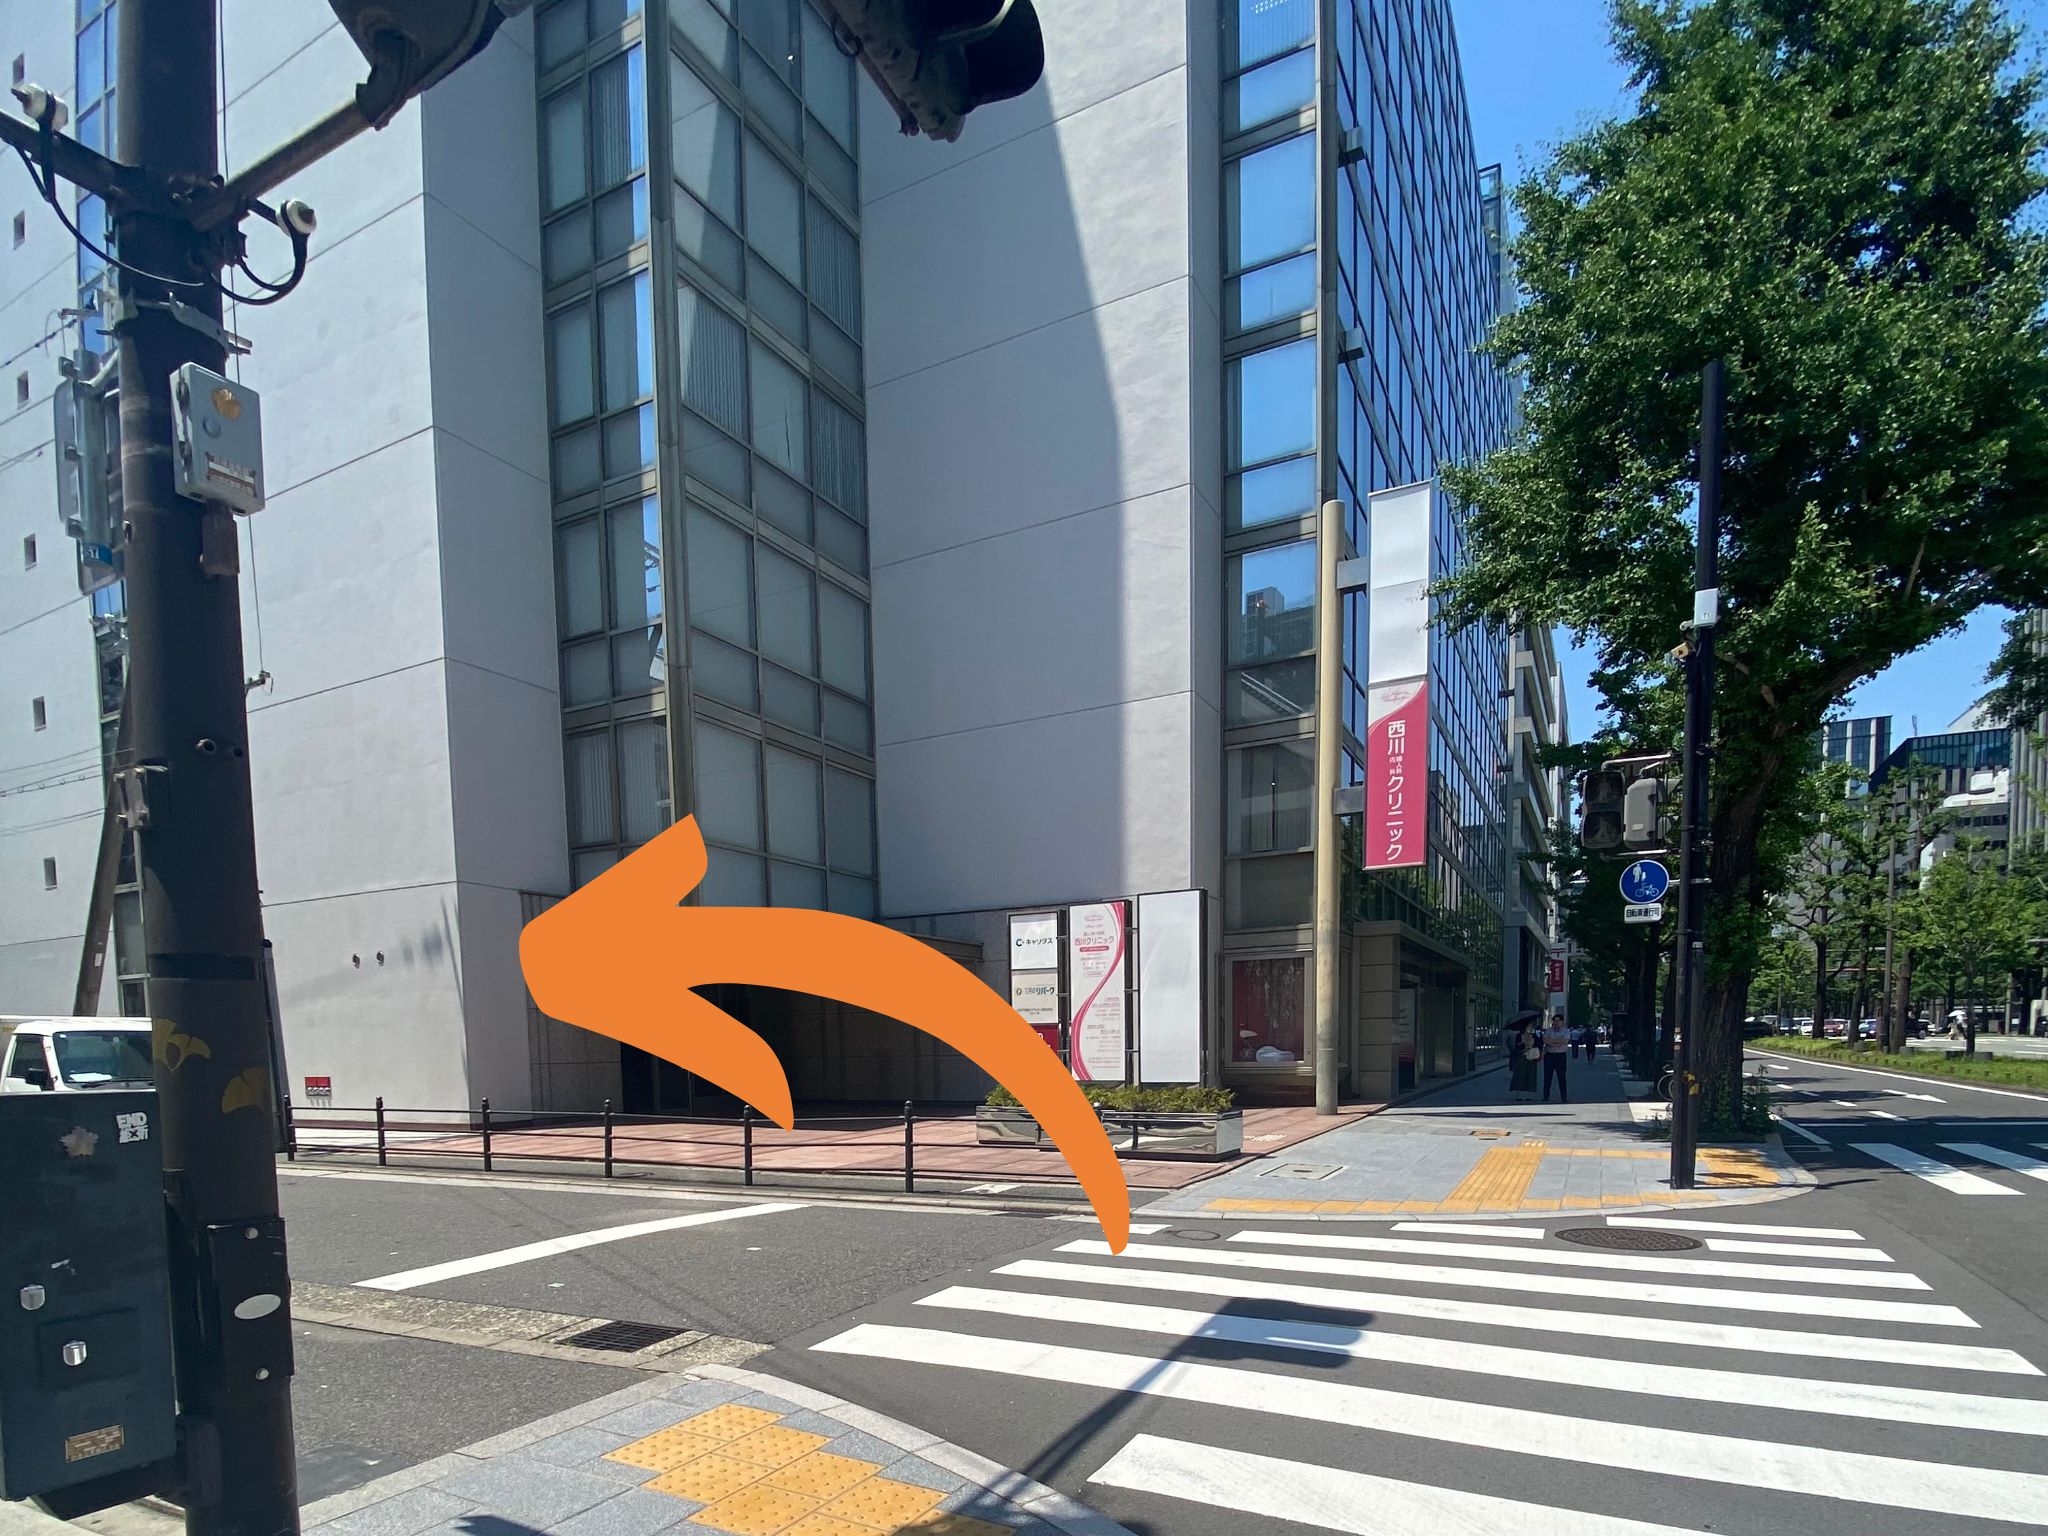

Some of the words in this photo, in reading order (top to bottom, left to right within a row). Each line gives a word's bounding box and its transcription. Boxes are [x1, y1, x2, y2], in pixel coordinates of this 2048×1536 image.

[1626, 907, 1660, 918] 自転車通行可
[1074, 936, 1115, 946] 西川クリニック
